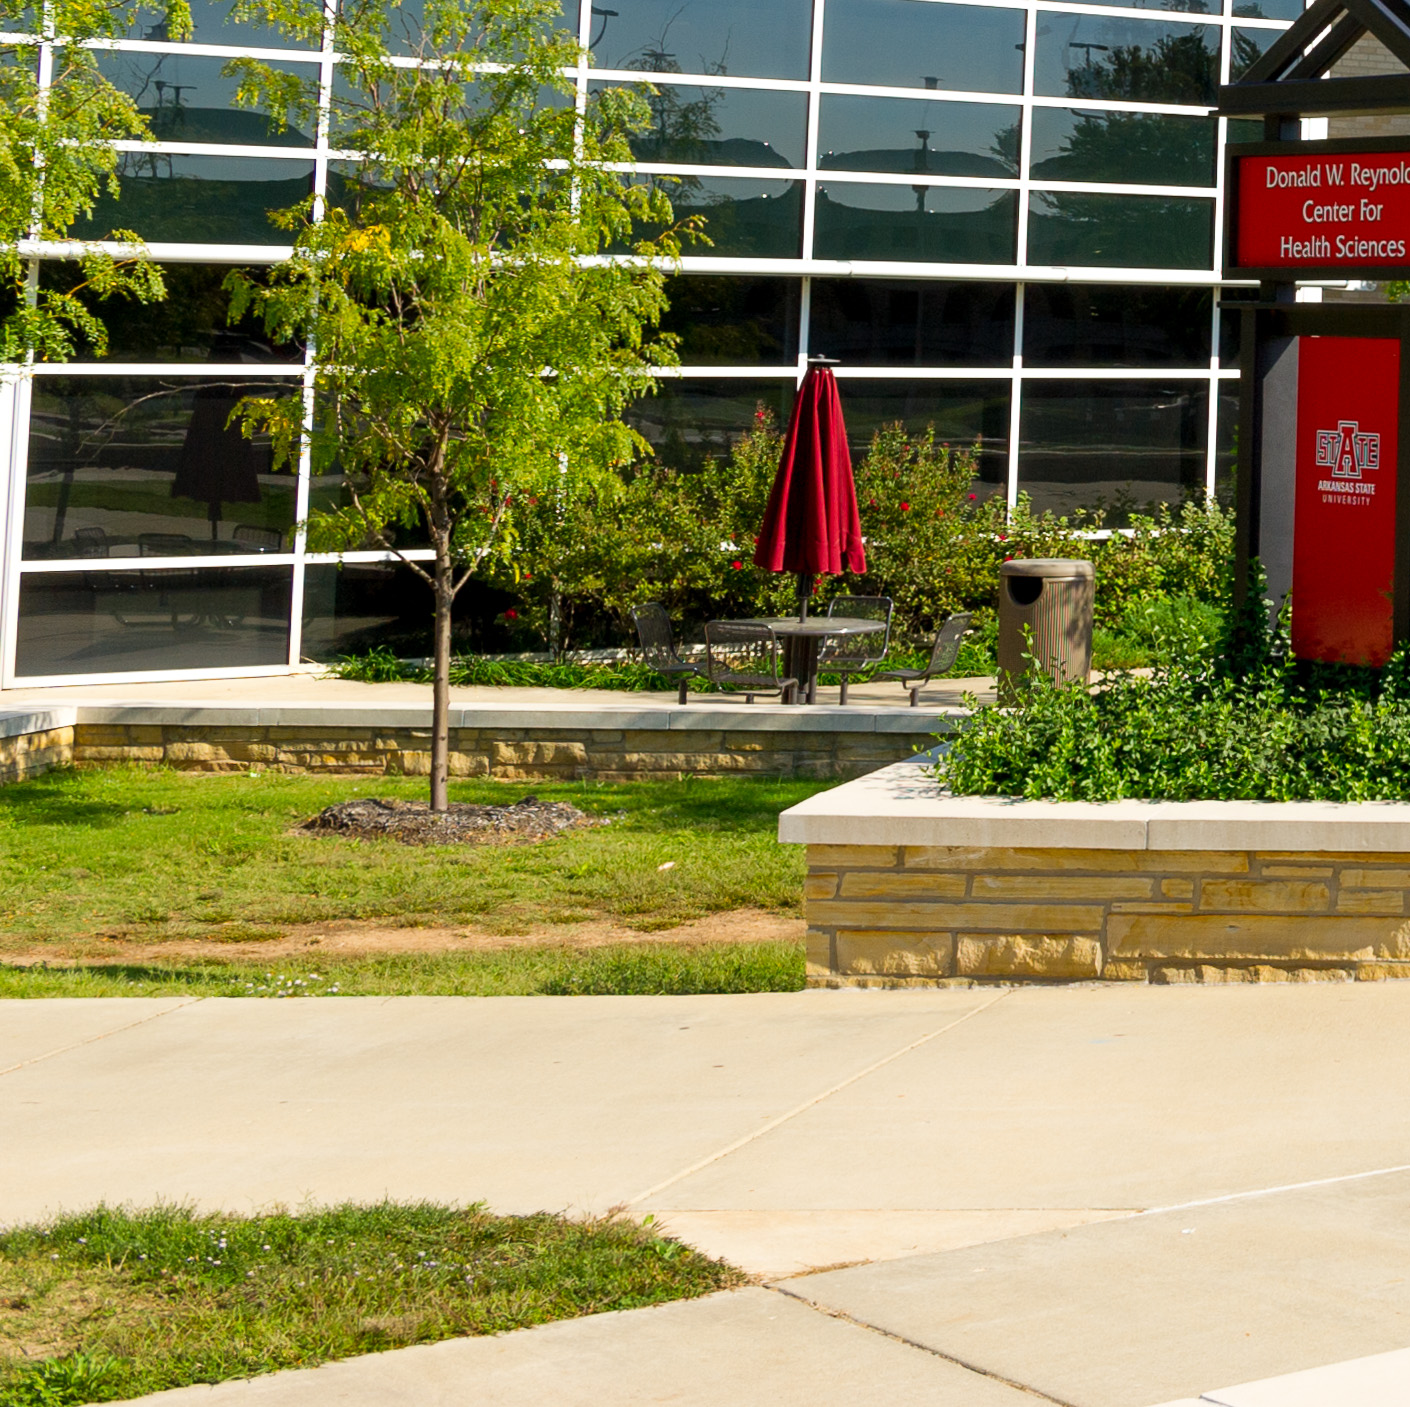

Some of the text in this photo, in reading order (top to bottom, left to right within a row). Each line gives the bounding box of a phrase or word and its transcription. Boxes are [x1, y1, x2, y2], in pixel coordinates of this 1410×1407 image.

[1266, 164, 1321, 188] Donald
[1325, 163, 1345, 186] W.
[1302, 198, 1384, 223] Center For
[1280, 235, 1406, 258] Health Sciences
[1317, 480, 1376, 495] ARKANSAS STATE
[1322, 494, 1371, 506] UNIVERSITY
